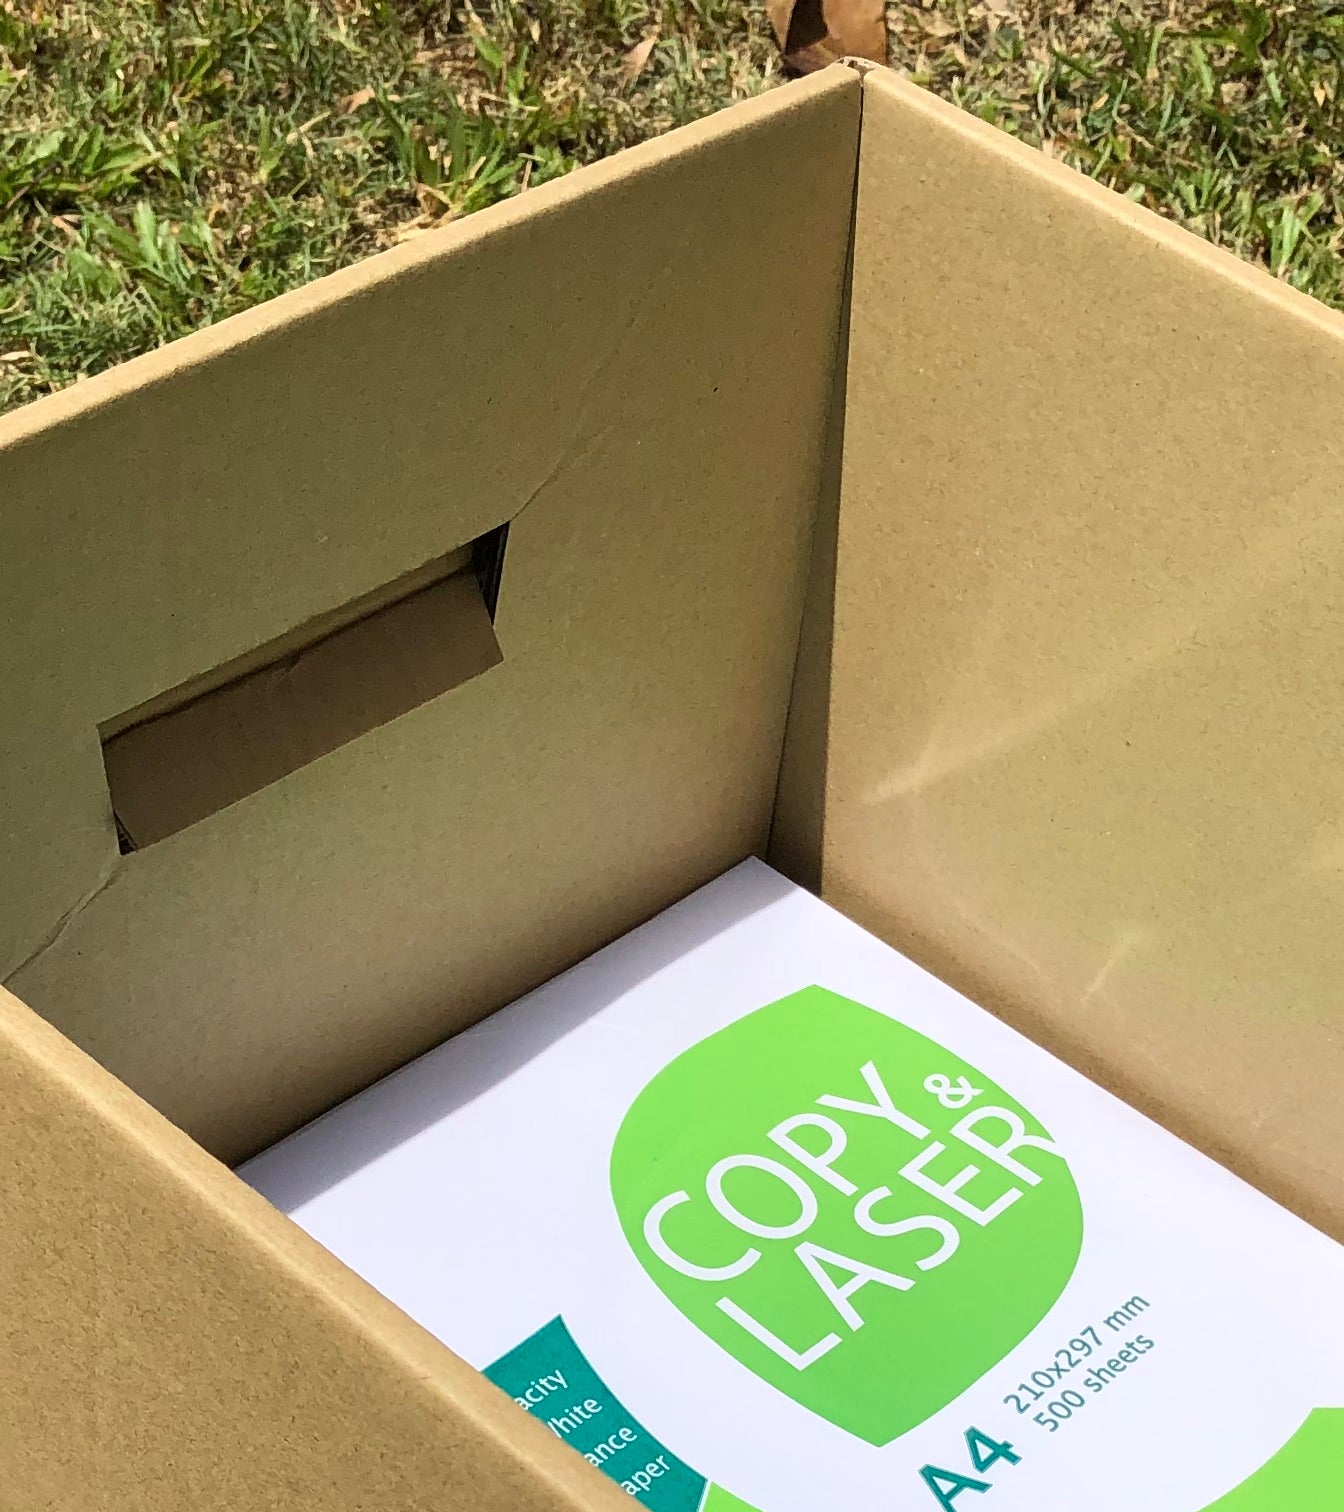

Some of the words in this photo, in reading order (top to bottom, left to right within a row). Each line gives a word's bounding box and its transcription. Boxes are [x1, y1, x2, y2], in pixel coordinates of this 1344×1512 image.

[643, 1060, 933, 1281] COPY
[923, 1073, 984, 1109] &
[715, 1104, 1057, 1372] LASER
[1002, 1326, 1103, 1414] 210x297
[1103, 1295, 1151, 1332] mm
[1032, 1389, 1086, 1432] 500
[1083, 1334, 1155, 1393] sheets
[584, 1427, 638, 1467] ance
[621, 1455, 671, 1495] aper
